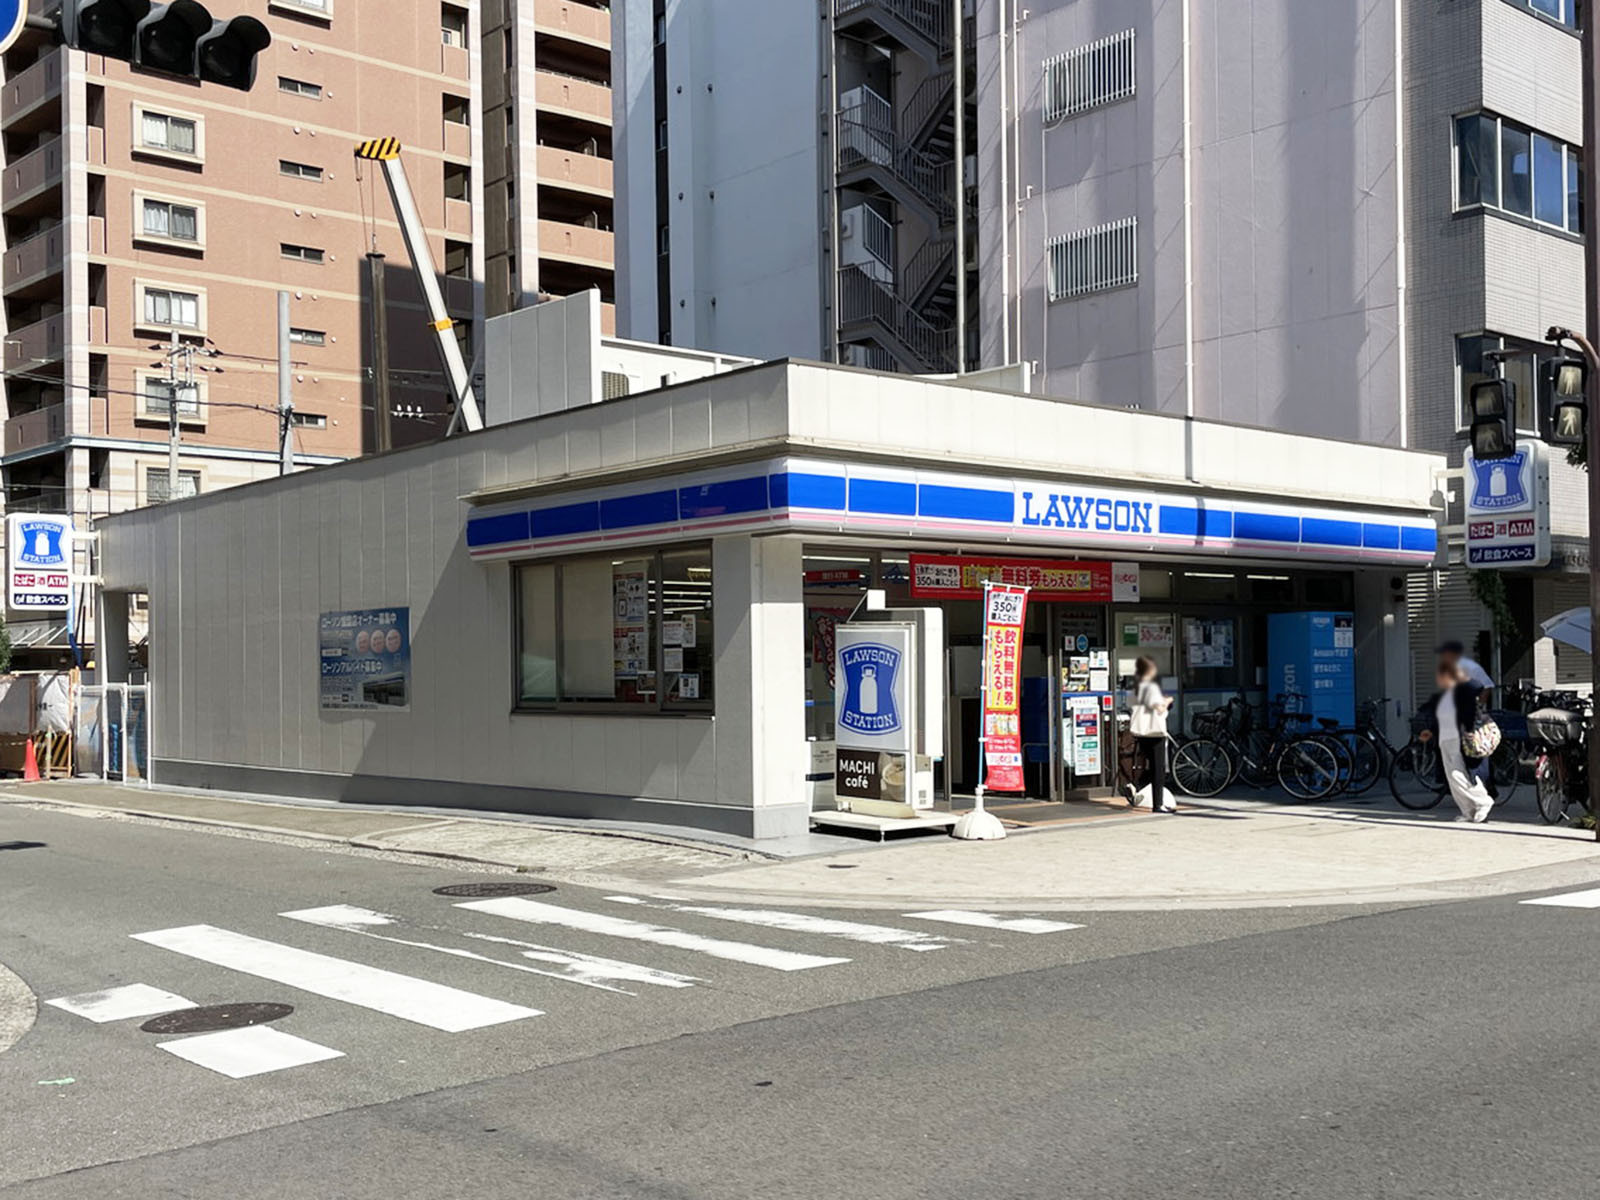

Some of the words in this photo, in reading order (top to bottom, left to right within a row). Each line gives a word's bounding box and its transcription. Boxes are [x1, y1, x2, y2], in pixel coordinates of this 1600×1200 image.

[1475, 492, 1522, 506] STATION
[1022, 492, 1153, 533] LAWSON
[23, 521, 62, 533] LAWSON
[1510, 521, 1534, 535] ATM
[23, 553, 61, 563] STATION
[48, 575, 68, 587] ATM
[844, 649, 896, 667] LAWSON
[1004, 629, 1016, 706] 飲料無料券
[844, 710, 895, 729] STATION
[839, 758, 875, 776] MACHI
[845, 775, 869, 788] café
